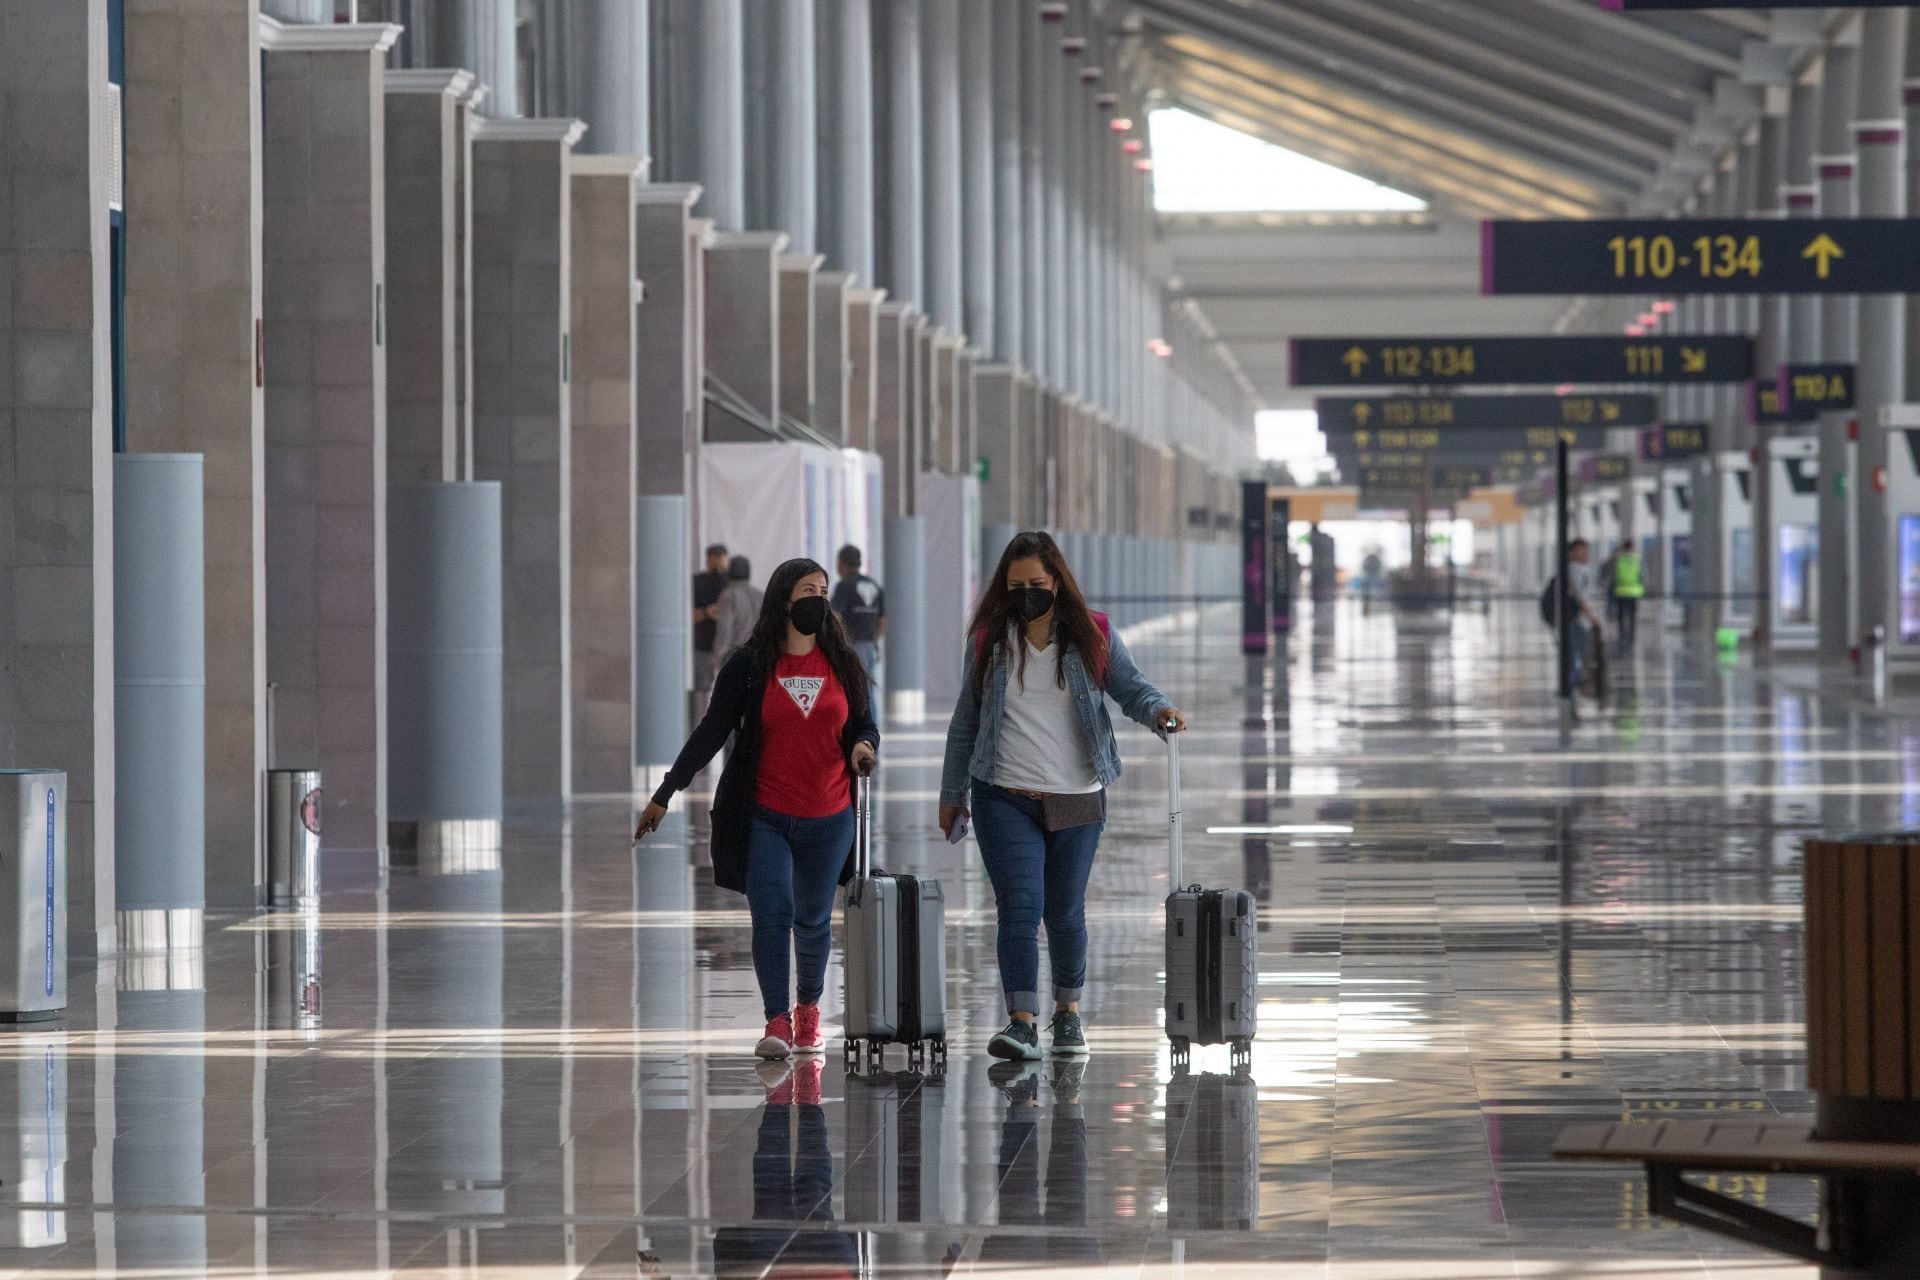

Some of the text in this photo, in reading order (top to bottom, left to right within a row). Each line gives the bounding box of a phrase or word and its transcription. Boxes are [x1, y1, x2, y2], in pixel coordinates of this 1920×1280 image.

[1607, 235, 1761, 278] 110-134
[1383, 346, 1663, 376] 112-134 111
[783, 679, 820, 689] GUESS
